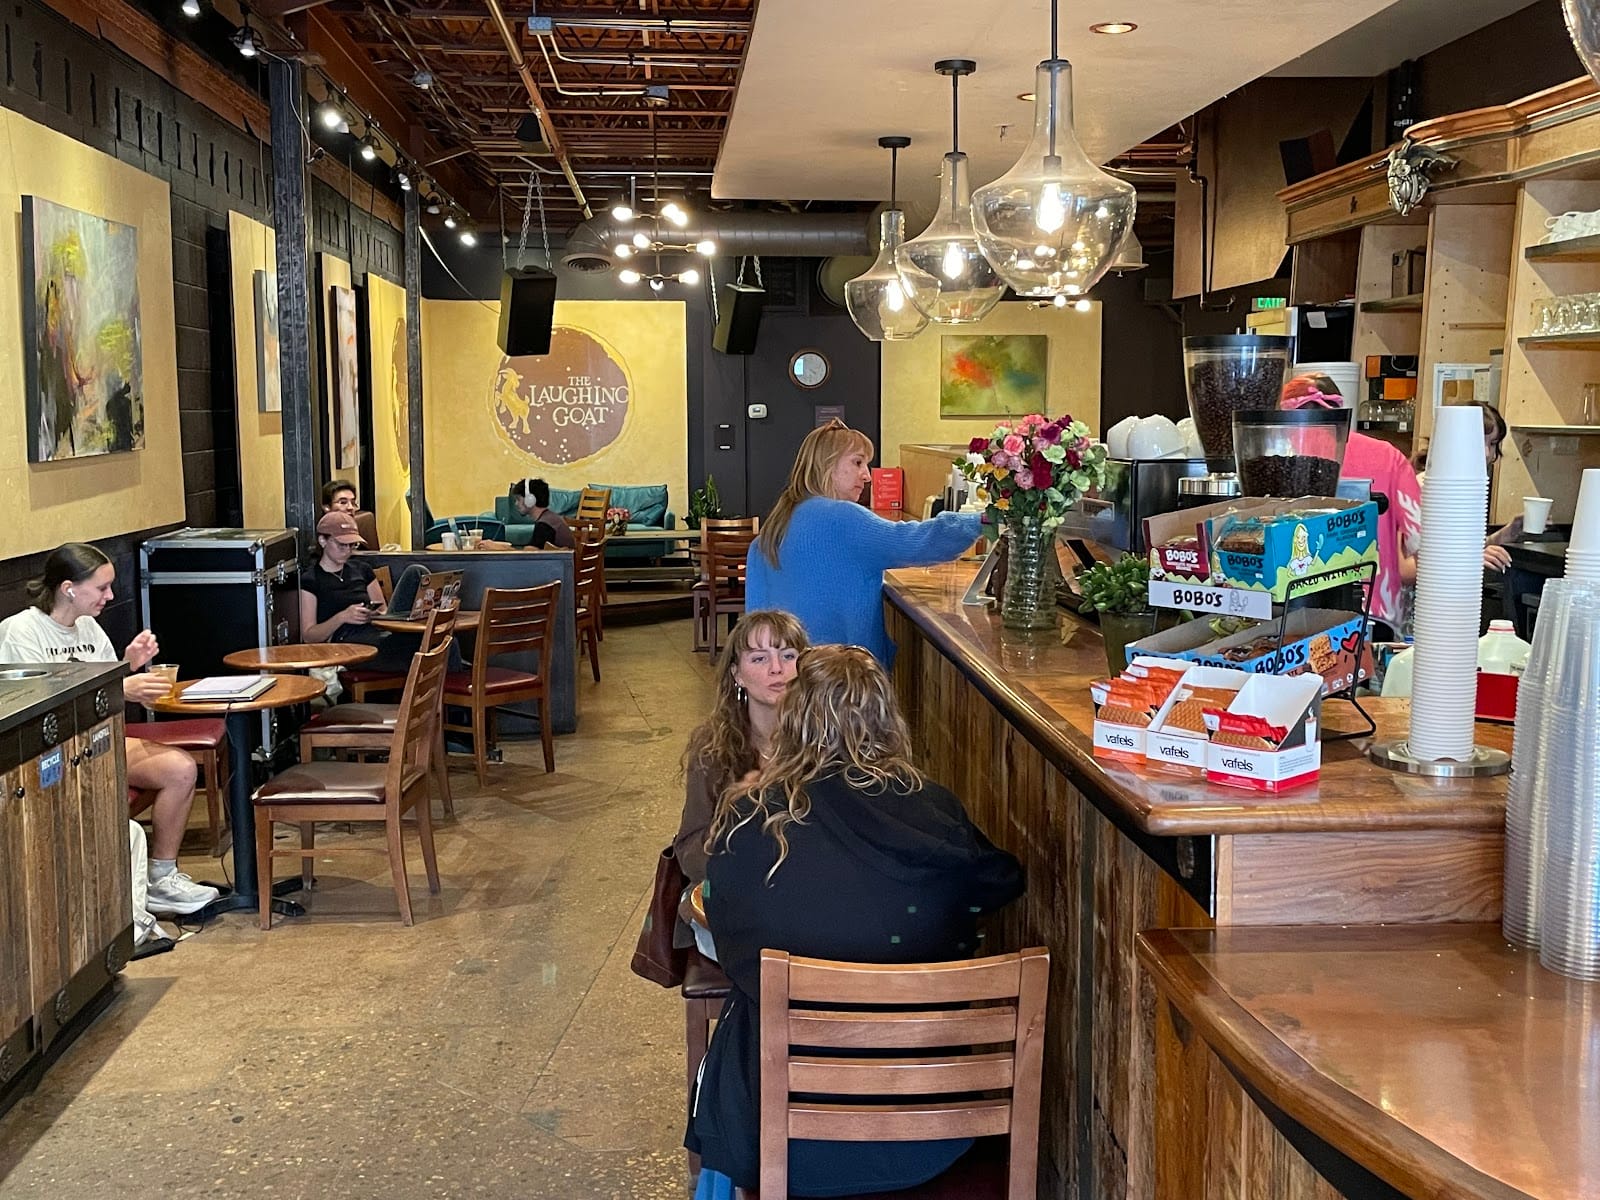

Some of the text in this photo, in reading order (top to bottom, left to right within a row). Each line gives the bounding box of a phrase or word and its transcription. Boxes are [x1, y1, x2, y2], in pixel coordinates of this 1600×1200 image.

[568, 376, 592, 386] THE
[529, 385, 629, 407] LAUGHING
[552, 406, 609, 427] GOAT
[1165, 549, 1199, 563] BOBO'S
[1227, 555, 1264, 569] BOBO'S
[1173, 589, 1223, 607] BOBO'S
[1105, 733, 1134, 747] vafels
[1160, 744, 1189, 759] vafels
[1221, 757, 1253, 772] vafels
